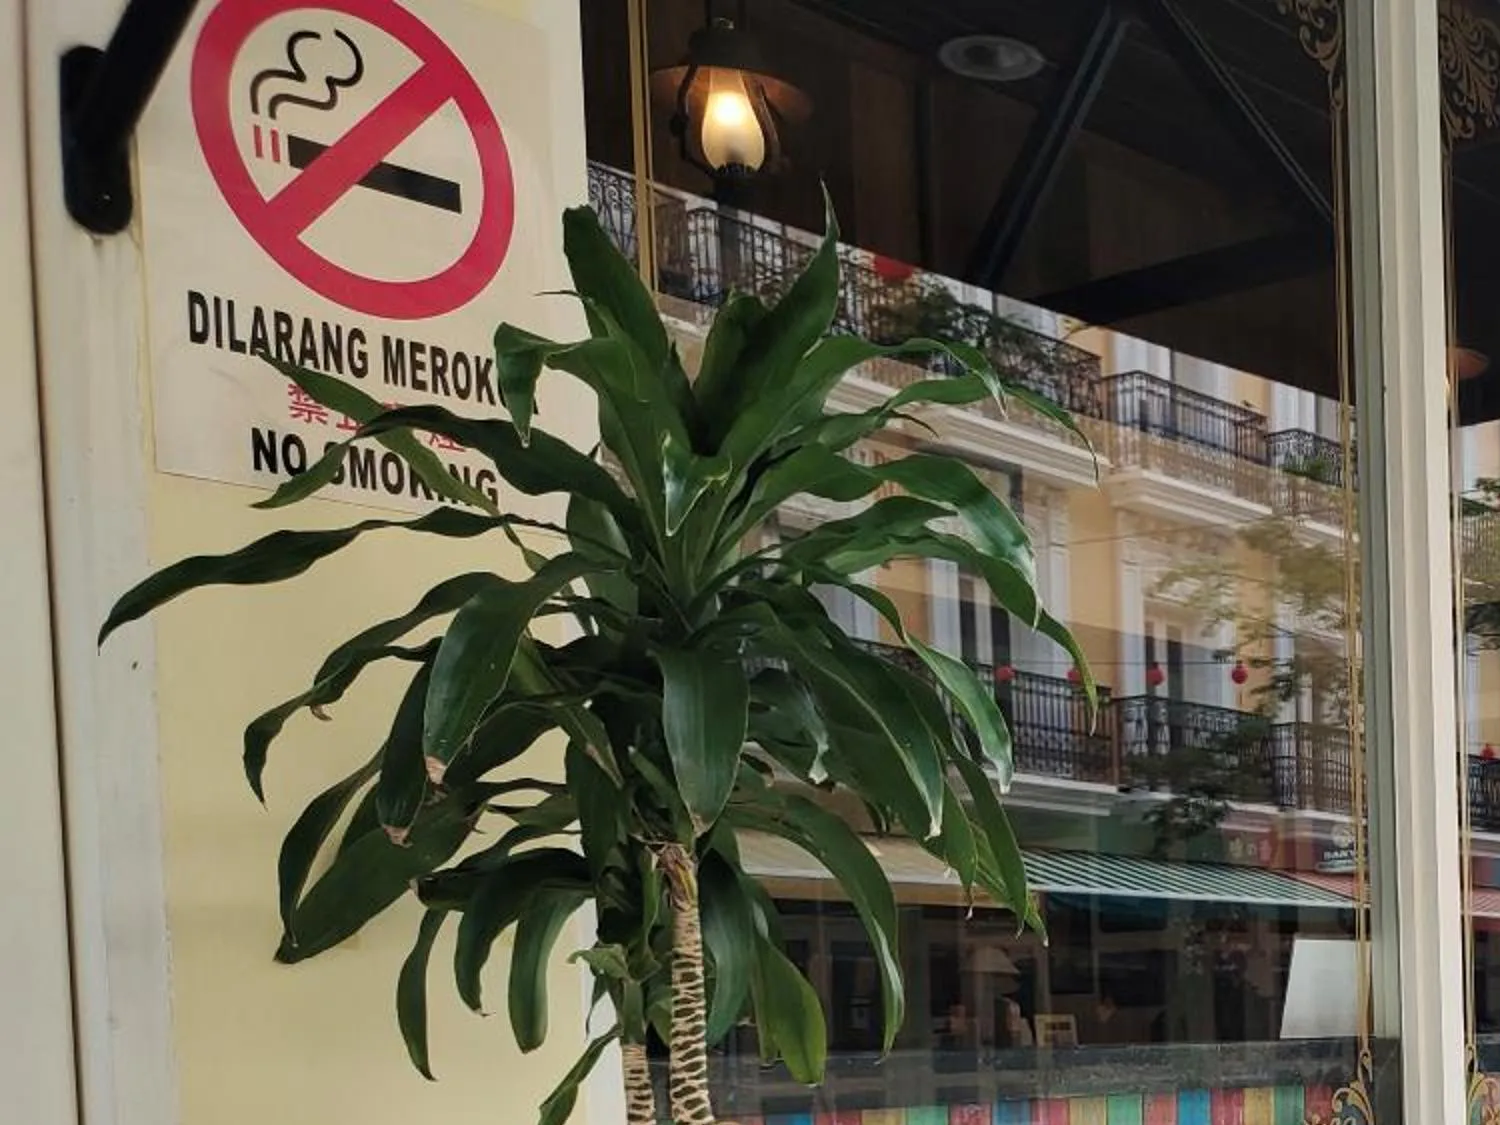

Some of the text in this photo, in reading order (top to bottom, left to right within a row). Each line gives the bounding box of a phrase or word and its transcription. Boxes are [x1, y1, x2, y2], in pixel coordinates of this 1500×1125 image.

[187, 290, 539, 415] DILARANG MEROK
[251, 427, 499, 508] NO MOKNG
